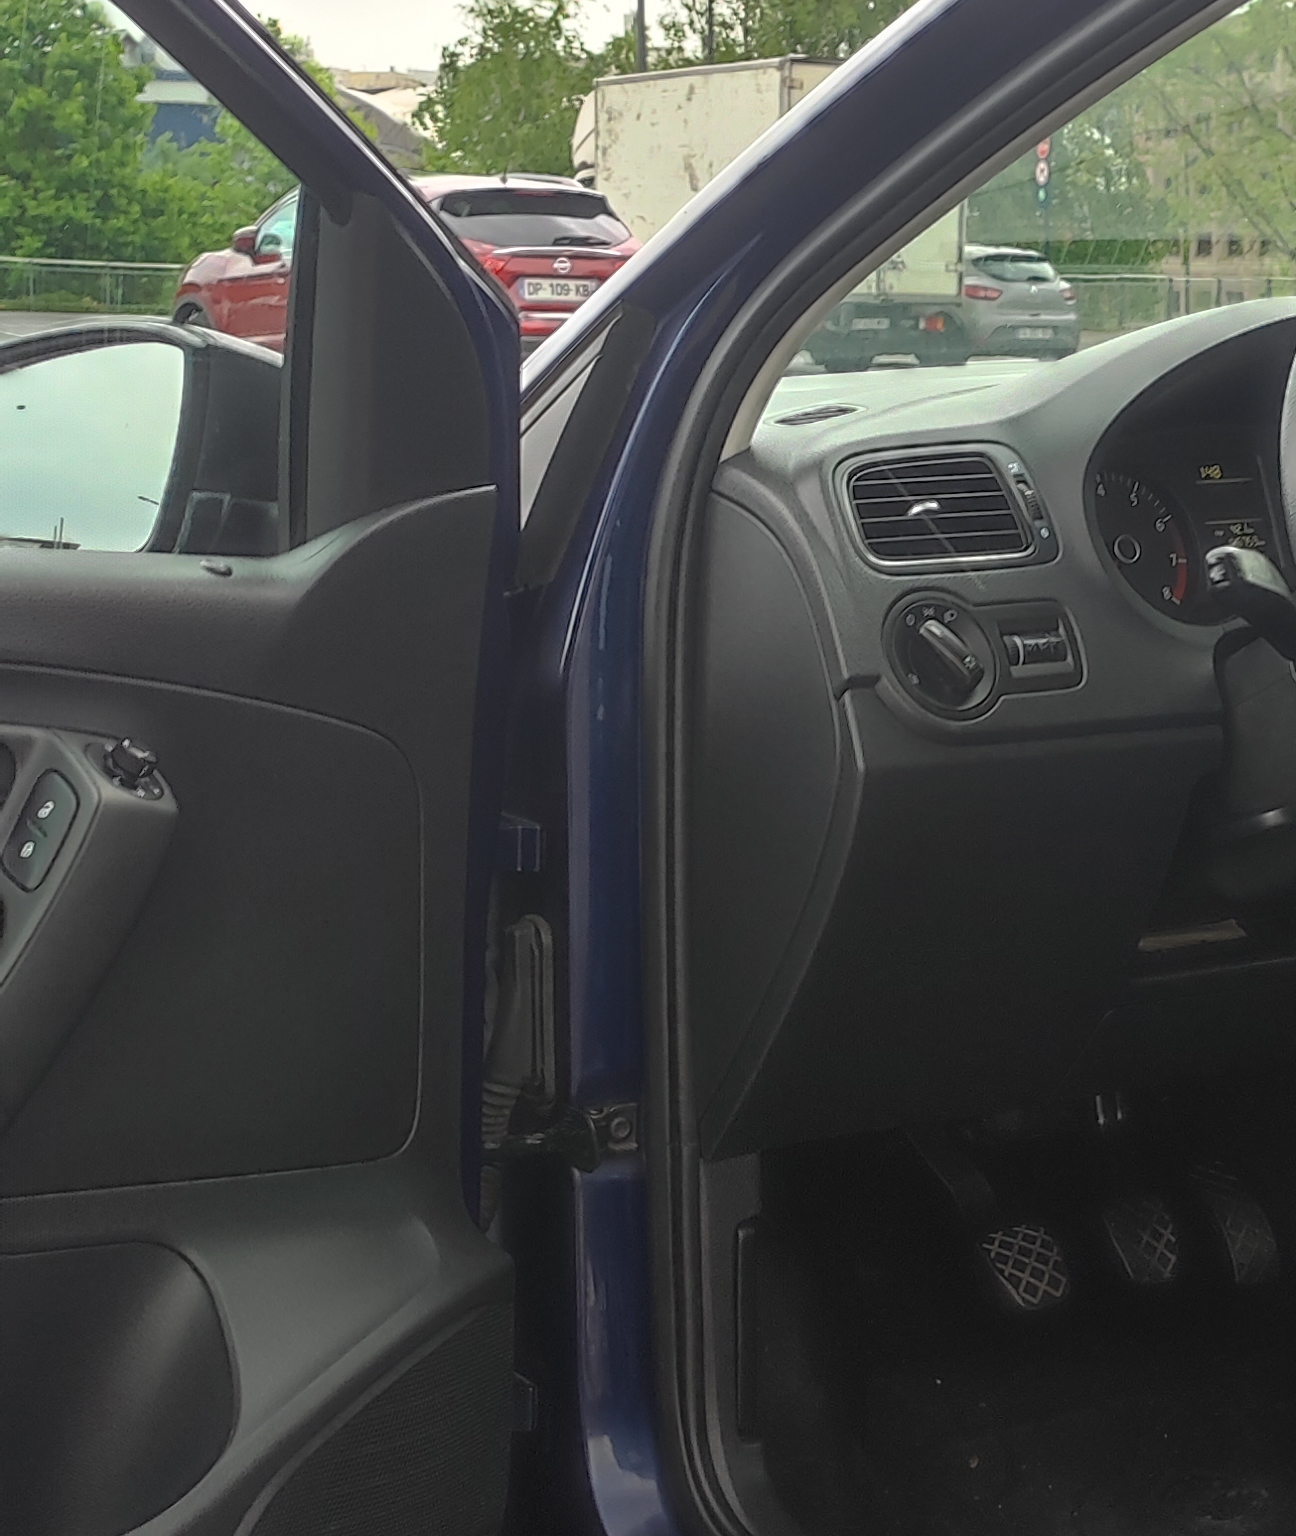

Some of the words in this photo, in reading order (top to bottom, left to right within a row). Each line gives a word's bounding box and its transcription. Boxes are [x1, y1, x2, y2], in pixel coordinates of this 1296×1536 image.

[1129, 493, 1139, 507] 5
[1155, 518, 1166, 533] 6
[1169, 553, 1178, 567] 7
